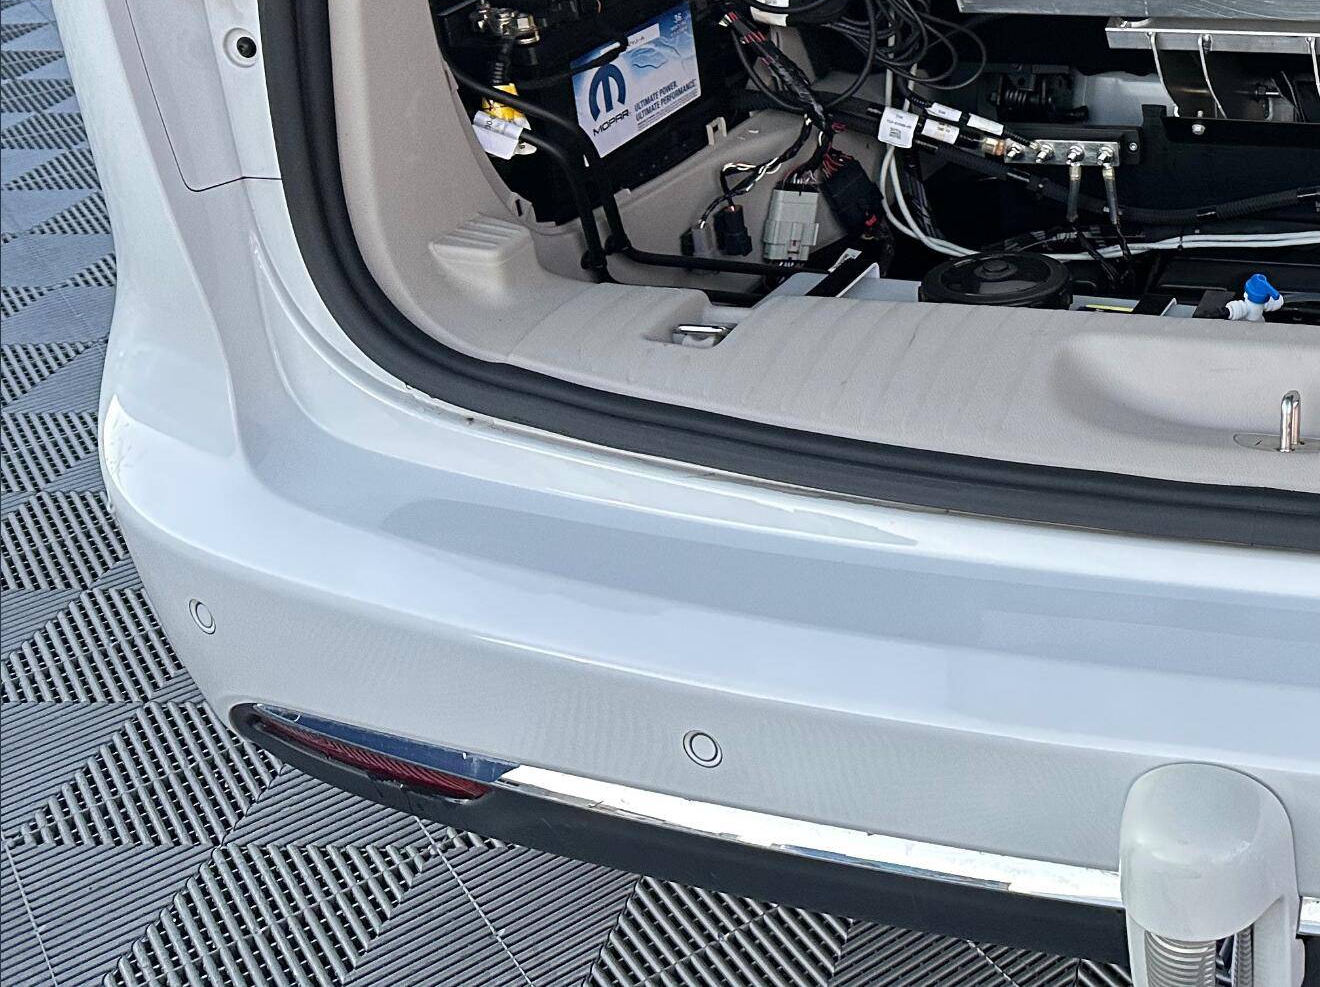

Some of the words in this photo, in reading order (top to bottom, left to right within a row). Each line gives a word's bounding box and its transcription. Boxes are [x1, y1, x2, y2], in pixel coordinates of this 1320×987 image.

[634, 88, 659, 112] ULTIMATE
[635, 99, 660, 122] ULTIMATE
[592, 109, 630, 136] MOPAR
